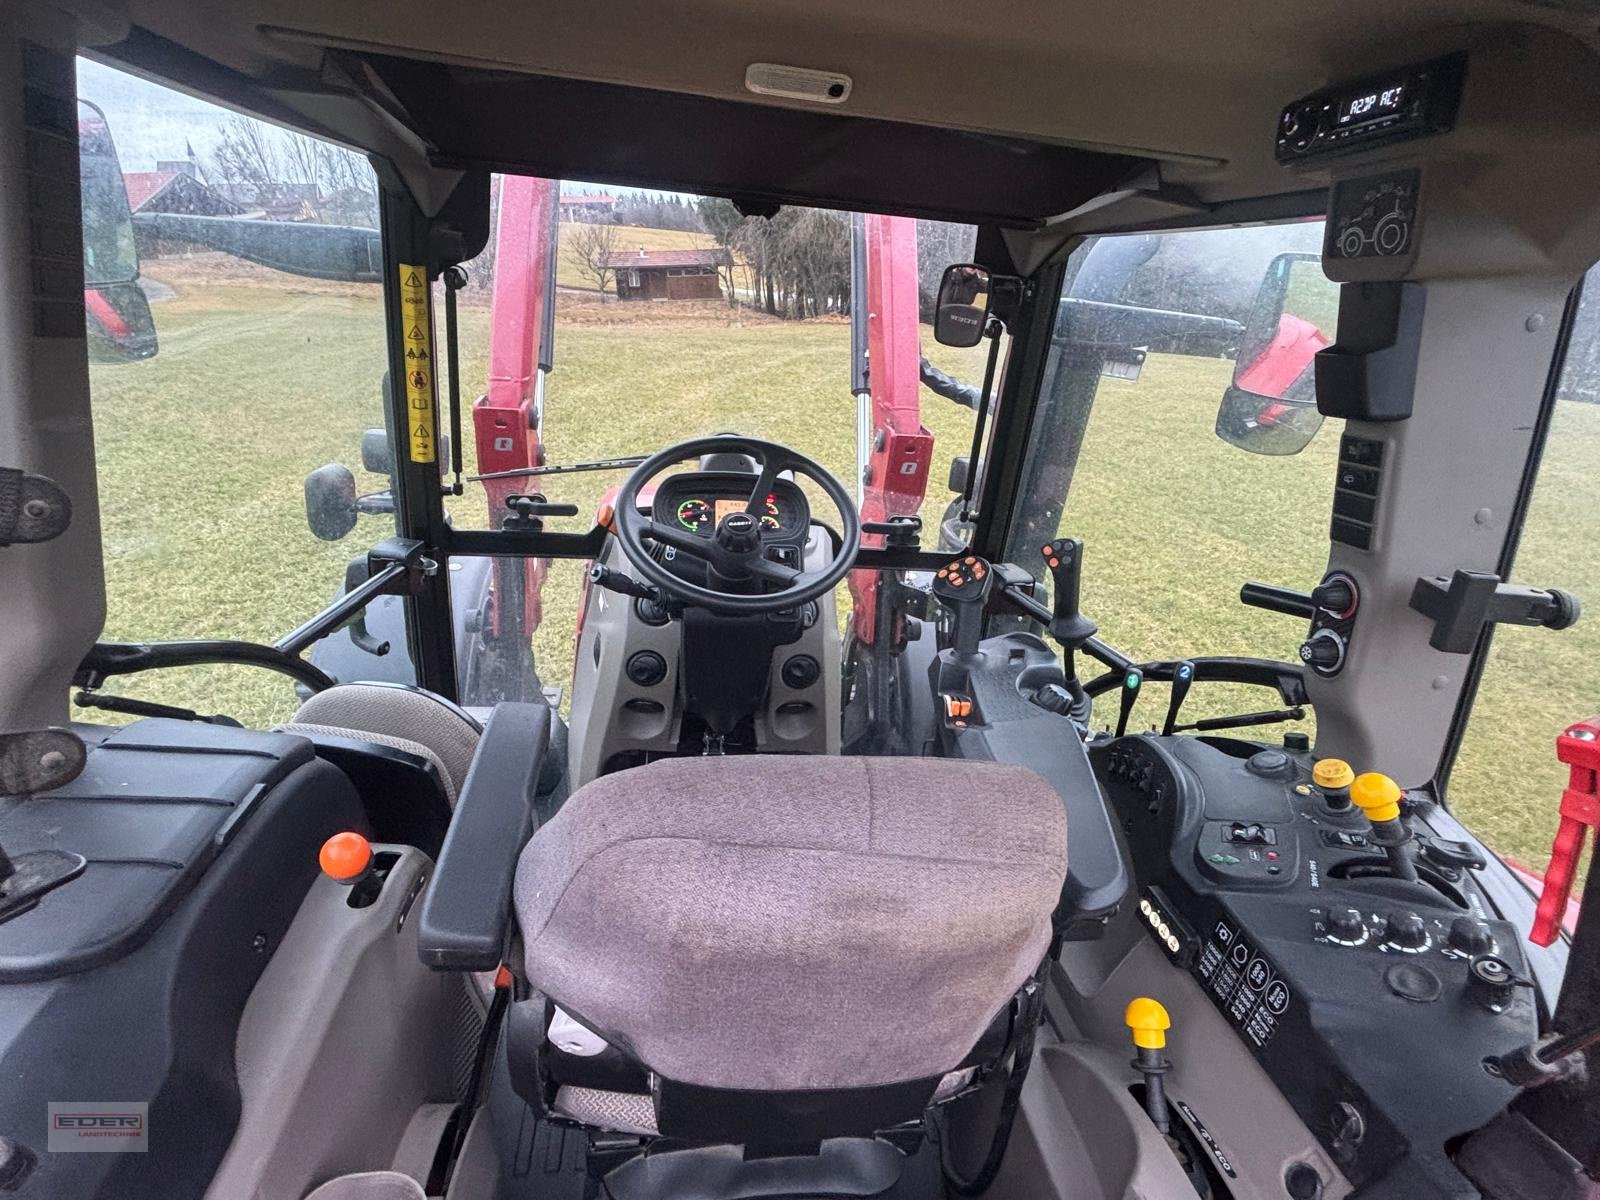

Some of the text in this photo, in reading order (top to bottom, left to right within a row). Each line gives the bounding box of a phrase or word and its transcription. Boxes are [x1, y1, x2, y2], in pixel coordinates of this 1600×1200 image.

[1180, 665, 1190, 678] 2
[1238, 991, 1251, 1008] 1000
[1241, 984, 1255, 1001] 1000
[1259, 1006, 1274, 1025] ECO
[1231, 1006, 1242, 1020] 540
[1235, 999, 1246, 1013] 540
[1251, 1020, 1265, 1038] ECO
[1215, 1150, 1230, 1170] ECO
